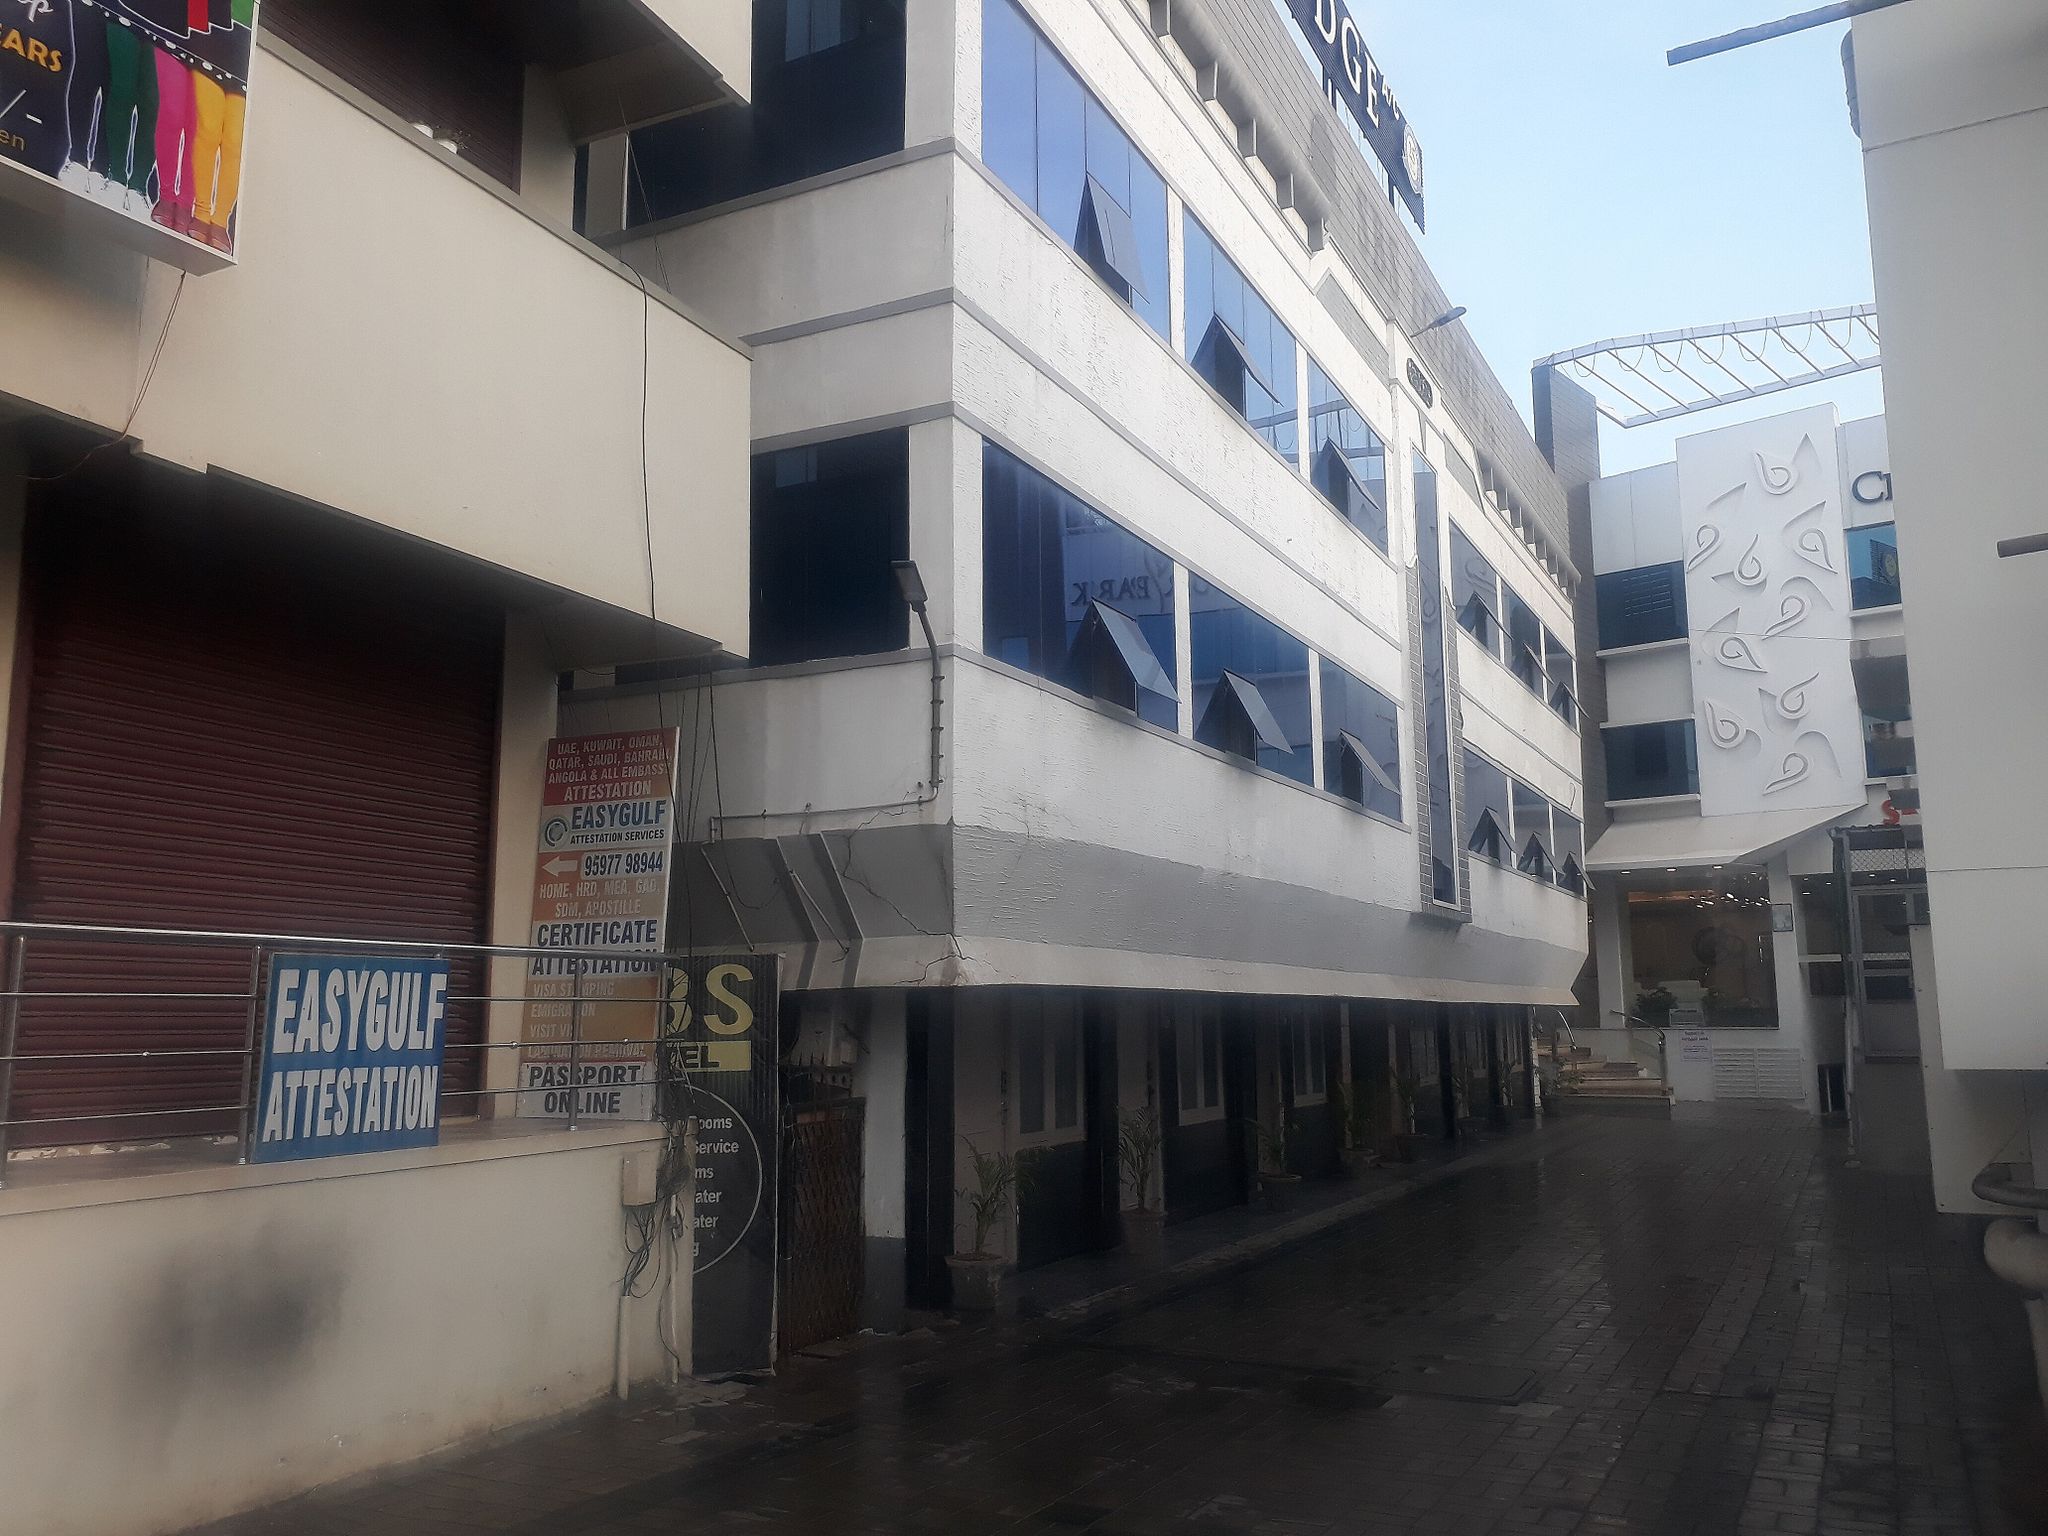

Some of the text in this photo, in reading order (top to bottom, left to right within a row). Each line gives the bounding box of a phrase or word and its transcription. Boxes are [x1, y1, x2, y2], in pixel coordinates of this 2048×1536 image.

[0, 23, 63, 72] ARS
[583, 737, 625, 753] KUWAIT,
[588, 753, 621, 767] SAUDI,
[548, 770, 587, 785] ANGOLA
[590, 769, 599, 781] &
[600, 767, 619, 780] ALL
[564, 780, 652, 801] ATTESTATION
[571, 800, 667, 830] EASYGULF
[570, 829, 665, 845] ATTESTATION SERVICES
[584, 851, 664, 877] 95977 98944
[584, 899, 641, 917] APOSTILLE
[537, 919, 658, 947] CERTIFICATE
[533, 983, 556, 997] VISA
[273, 967, 448, 1054] EASYGULF
[531, 1003, 596, 1018] EMIGRAON
[530, 1023, 557, 1038] VISIT
[262, 1065, 439, 1143] ATTESTATION
[695, 1189, 722, 1204] ater
[693, 1214, 719, 1229] ater
